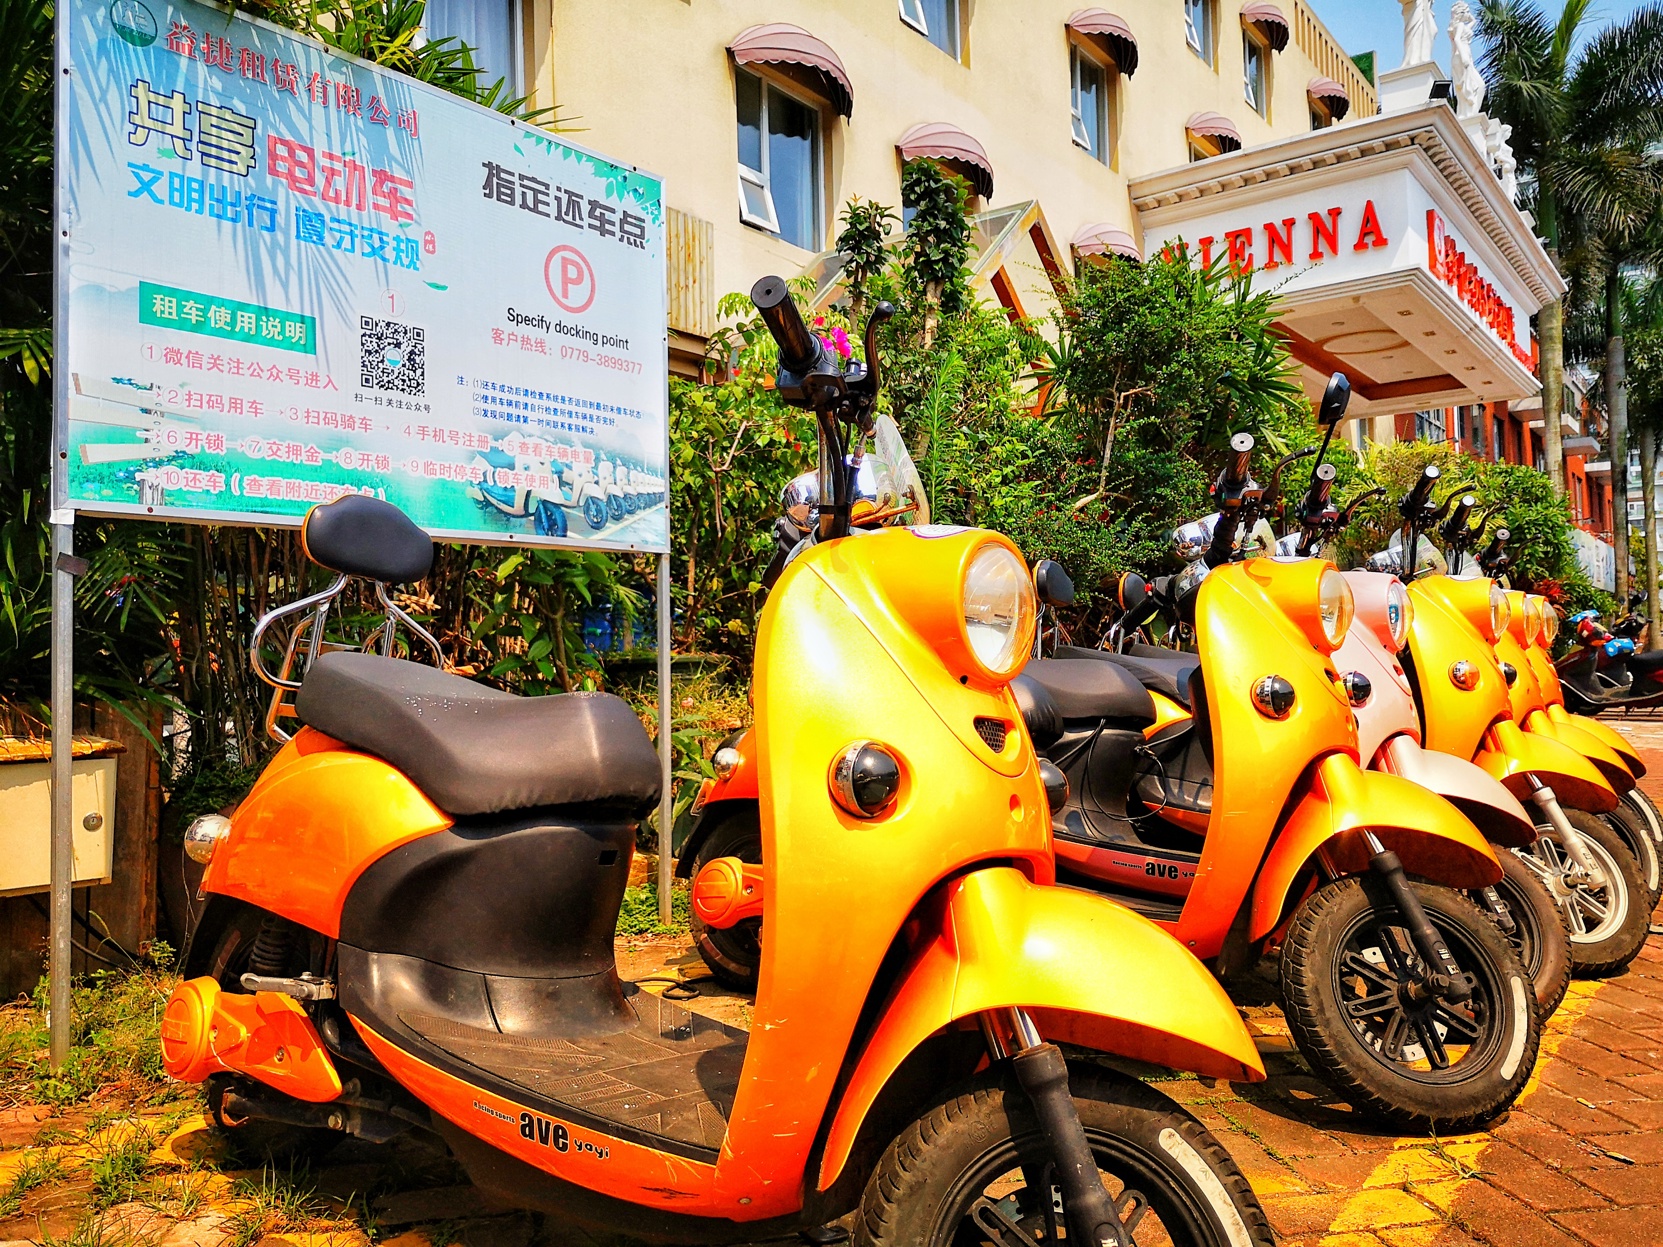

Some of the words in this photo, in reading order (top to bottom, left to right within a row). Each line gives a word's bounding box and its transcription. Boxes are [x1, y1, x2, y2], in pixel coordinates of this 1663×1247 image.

[165, 20, 420, 139] 益捷租赁有限公司
[127, 162, 277, 233] 文明出行
[295, 205, 420, 271] 遵守交规
[482, 161, 646, 250] 指定还车点
[152, 294, 308, 345] 租车使用说明
[506, 307, 551, 334] Specify
[554, 320, 599, 346] docking
[601, 334, 630, 351] point
[560, 344, 643, 375] 0779-3899377
[1145, 861, 1179, 880] ave
[519, 1111, 569, 1153] ave
[573, 1138, 610, 1159] yayi
